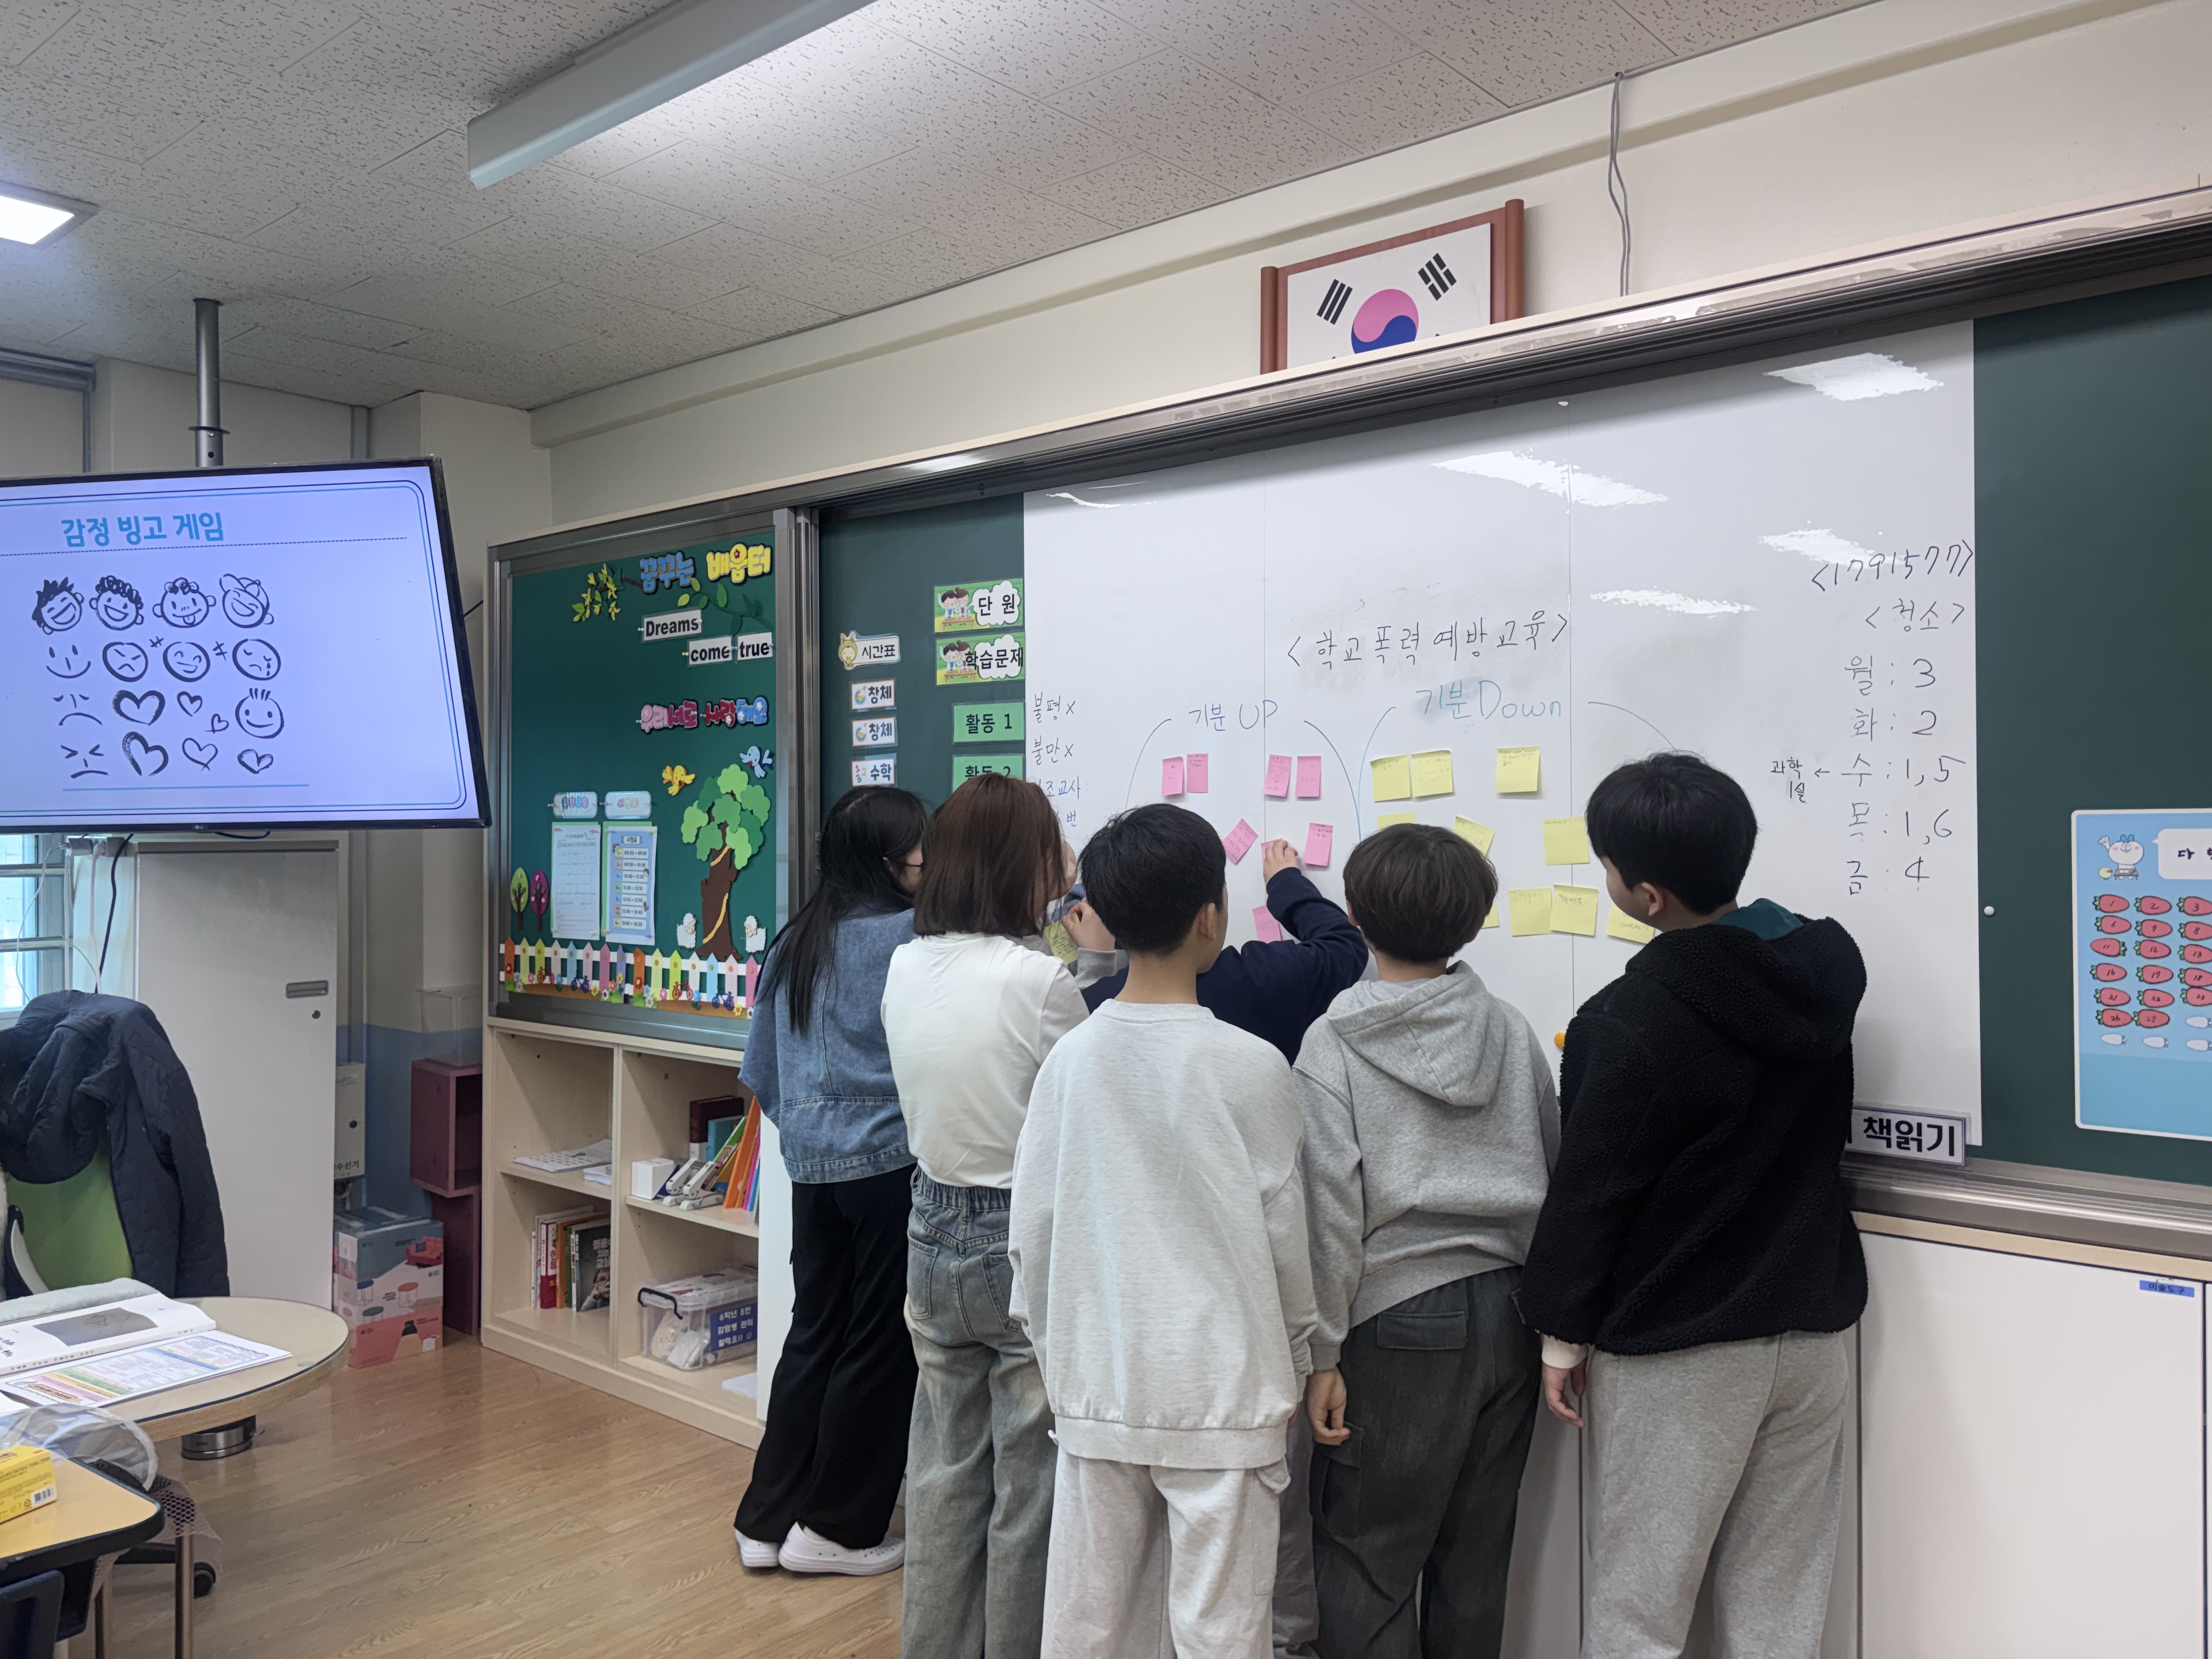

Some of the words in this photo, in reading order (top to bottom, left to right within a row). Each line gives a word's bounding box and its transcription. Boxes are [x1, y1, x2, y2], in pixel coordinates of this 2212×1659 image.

[61, 517, 109, 547] 감정
[117, 515, 167, 545] 빙고
[172, 512, 224, 541] 게임
[640, 551, 695, 593] 꿈꾸는
[706, 543, 771, 583] 배움터
[646, 618, 699, 637] Dreams
[691, 646, 730, 662] come
[739, 641, 770, 658] true
[862, 644, 896, 659] 시간표
[965, 647, 1024, 670] 학습문제
[1913, 658, 1936, 688] 3
[868, 685, 892, 704] 창체
[966, 714, 995, 734] 활동
[1004, 713, 1013, 729] 1
[1189, 703, 1226, 731] 기분
[1239, 700, 1278, 729] UP
[1912, 710, 1937, 735] 2
[869, 722, 893, 741] 창체
[871, 763, 892, 781] 수학
[1770, 757, 1803, 780] 과학
[2192, 903, 2199, 912] 3
[1863, 1116, 1955, 1156] 책읽기
[2149, 1282, 2186, 1294] 미술도구
[719, 1310, 737, 1321] 6학년
[740, 1306, 751, 1316] 5반
